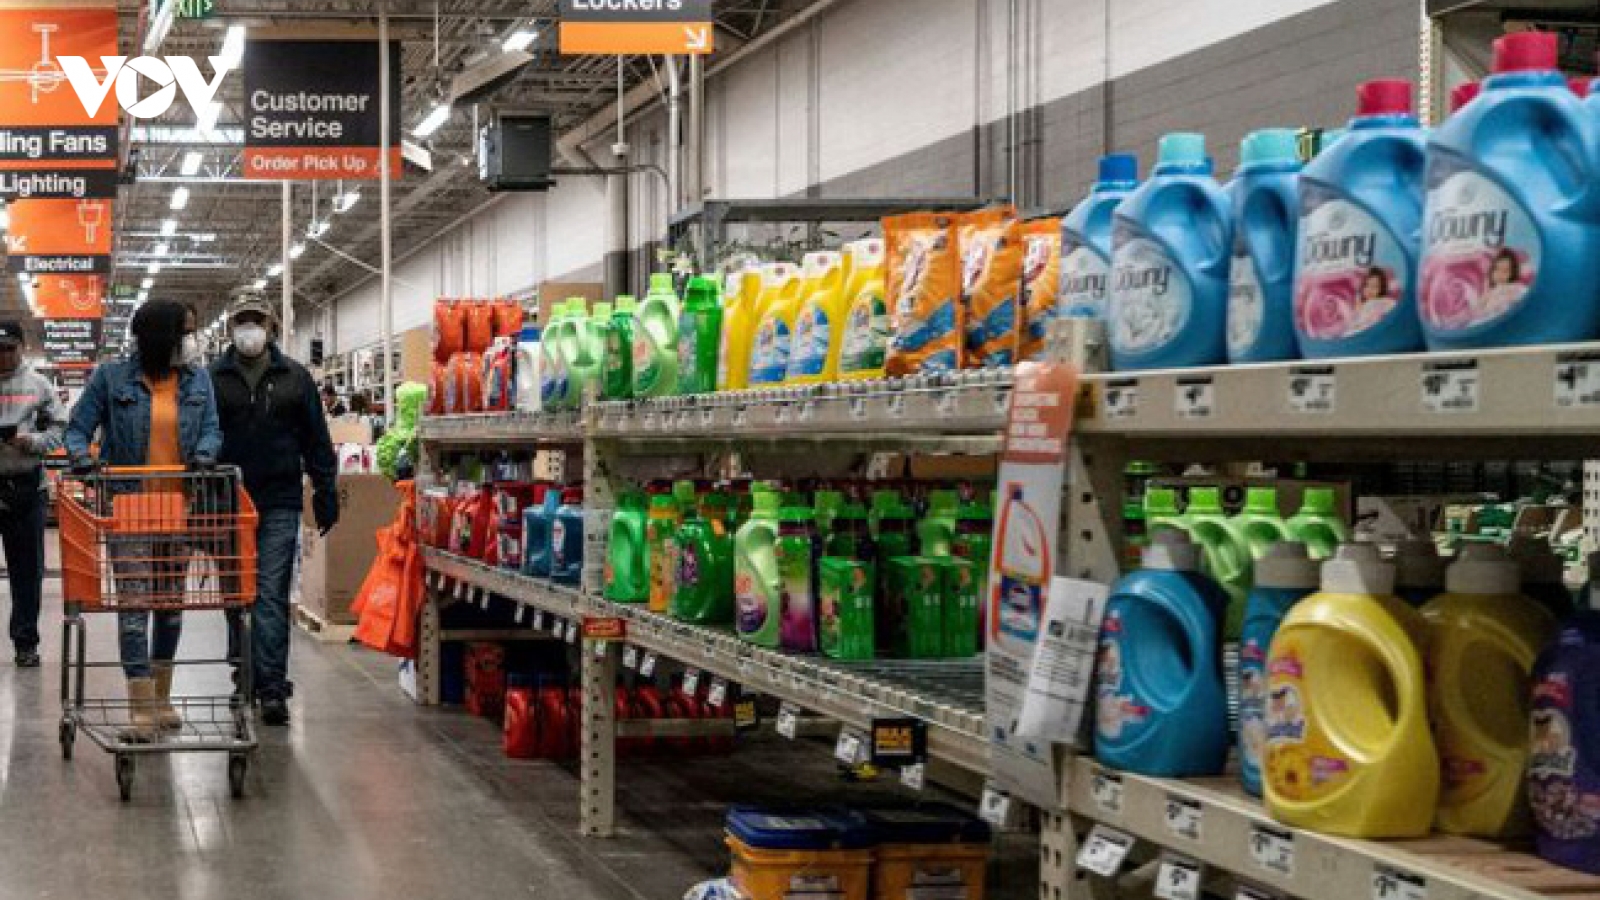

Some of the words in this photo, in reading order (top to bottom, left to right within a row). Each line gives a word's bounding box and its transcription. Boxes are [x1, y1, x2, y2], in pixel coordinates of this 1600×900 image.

[250, 90, 370, 111] Customer
[250, 116, 343, 138] Service
[49, 130, 107, 153] Fans
[250, 154, 299, 170] Order
[303, 154, 339, 170] Pick
[342, 154, 368, 172] Up
[0, 172, 86, 198] Lighting
